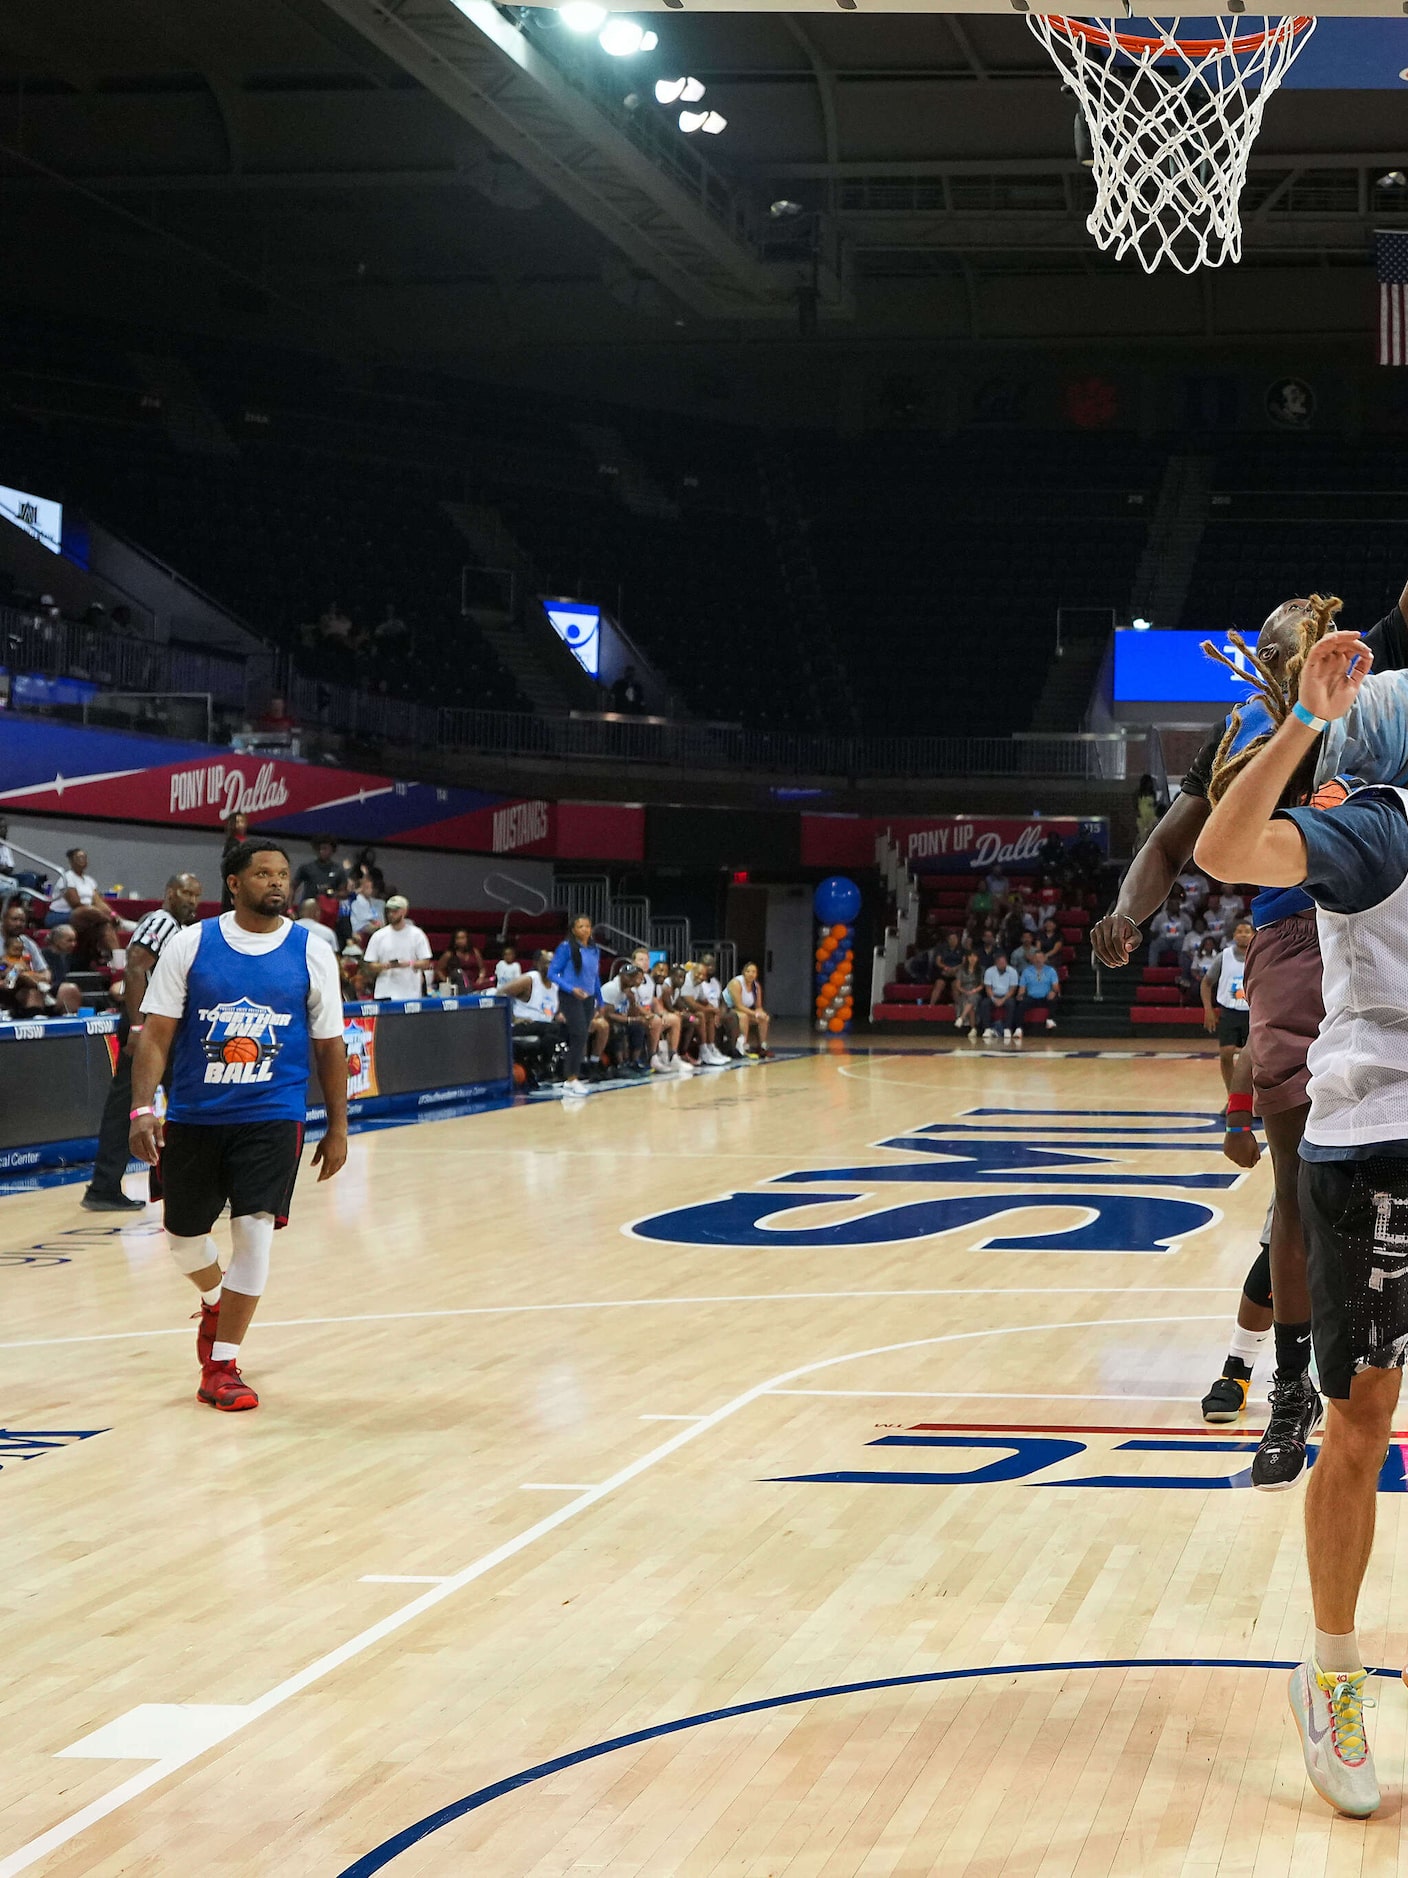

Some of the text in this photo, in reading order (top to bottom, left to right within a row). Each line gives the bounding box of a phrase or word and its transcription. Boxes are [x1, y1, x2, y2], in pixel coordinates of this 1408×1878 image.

[170, 761, 289, 820] PONY UP Dallas
[493, 800, 548, 853] MUSTANGS
[908, 824, 1049, 868] PONY UP Dall
[86, 1020, 115, 1035] UTSW
[198, 1008, 292, 1027] TOGETHER
[15, 1025, 45, 1040] UTSW
[223, 1022, 268, 1037] WE
[204, 1060, 273, 1084] BALL
[11, 1152, 40, 1166] Center
[620, 1107, 1268, 1254] SMU
